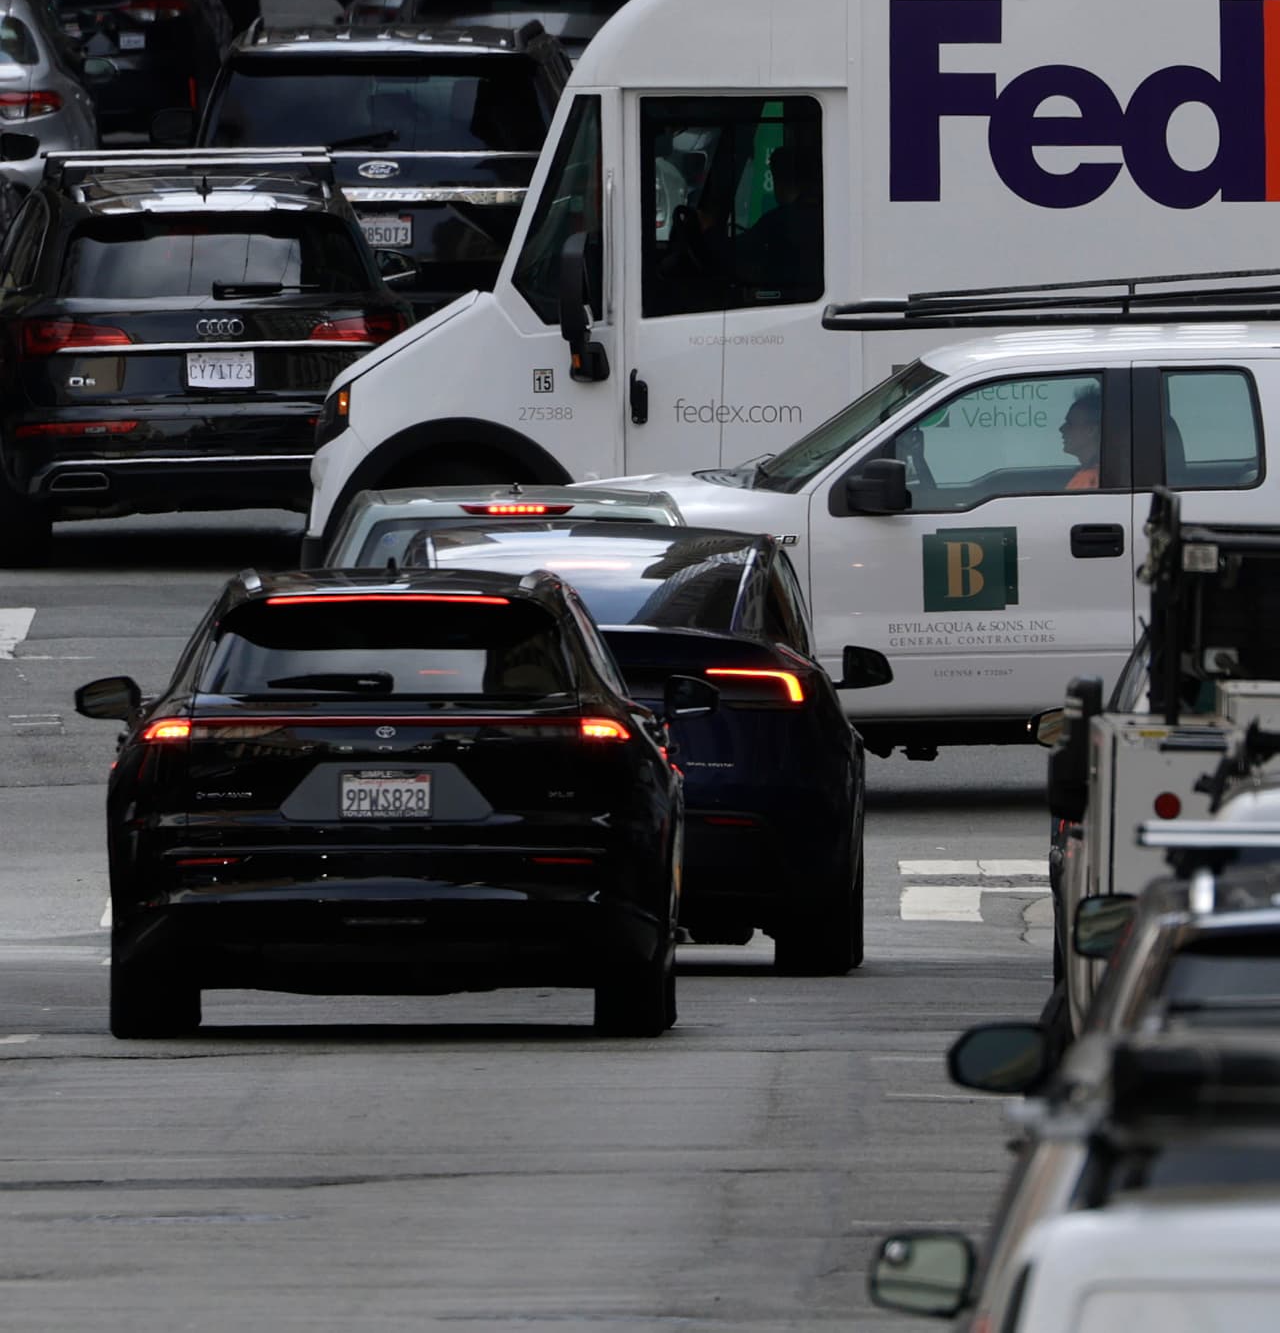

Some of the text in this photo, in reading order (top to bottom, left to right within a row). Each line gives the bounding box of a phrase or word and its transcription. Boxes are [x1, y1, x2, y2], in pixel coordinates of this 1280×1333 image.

[688, 335, 702, 346] NO
[750, 335, 785, 346] BOARD
[189, 363, 254, 381] CY71T23
[535, 374, 552, 391] 15
[518, 406, 573, 422] 275388
[673, 397, 803, 424] fedex.com
[962, 405, 1048, 429] Vehicle
[943, 541, 985, 599] B
[888, 622, 974, 635] BEVILACQUA
[976, 621, 987, 633] &
[889, 633, 1057, 648] GENERAL CONTRACTORS
[933, 668, 972, 678] LICENSE
[345, 788, 426, 811] 9PWS828
